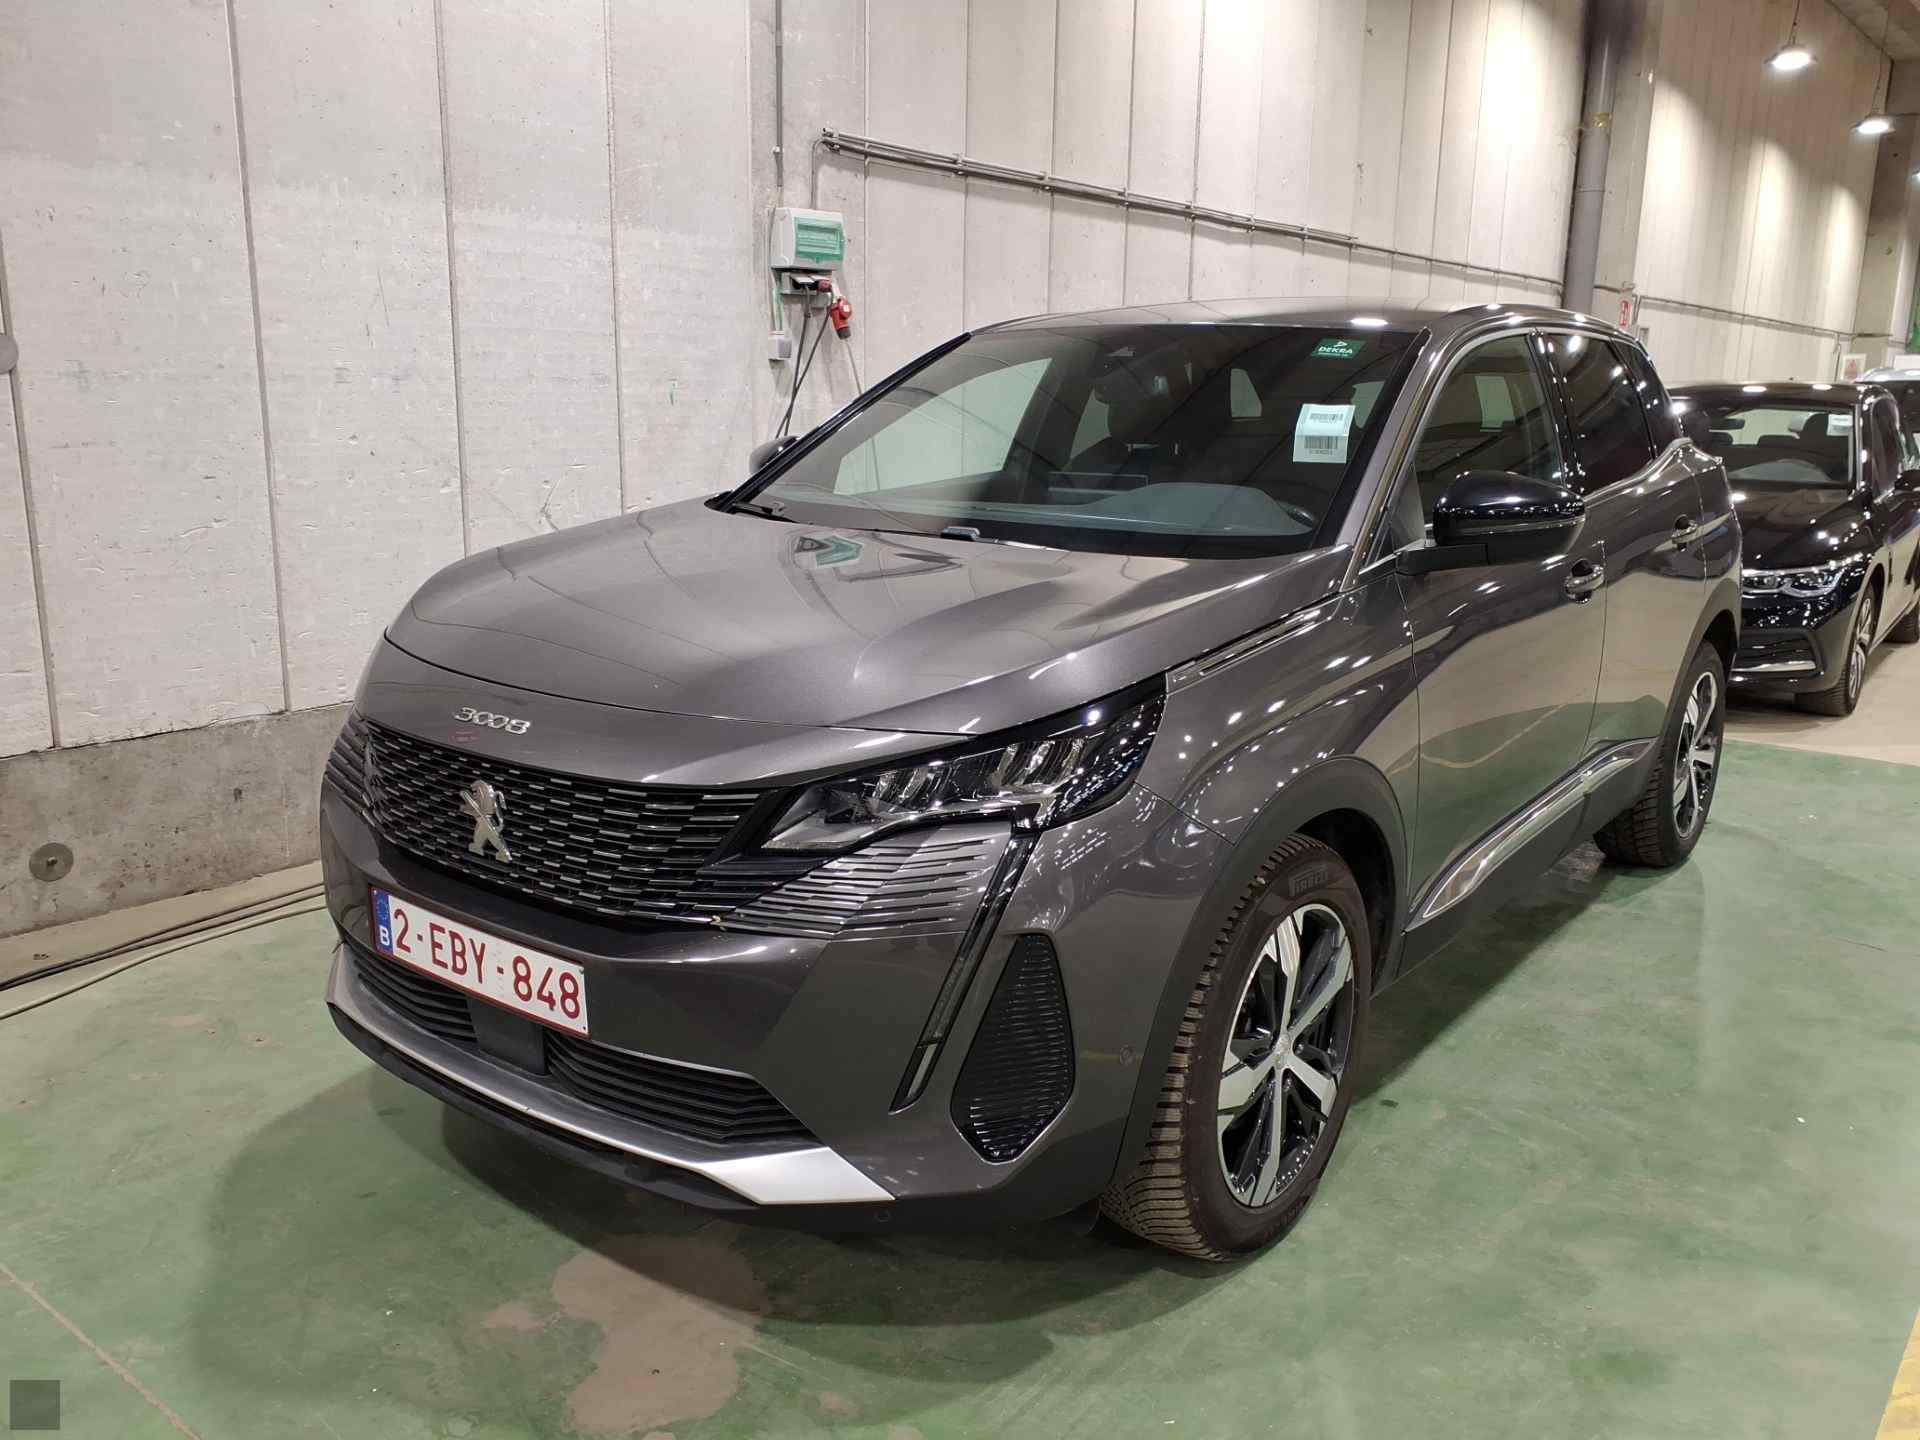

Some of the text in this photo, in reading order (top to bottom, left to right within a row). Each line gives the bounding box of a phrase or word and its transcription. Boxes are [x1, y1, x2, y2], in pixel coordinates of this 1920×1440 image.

[1318, 346, 1353, 354] DEKRA
[454, 706, 531, 734] 3008
[379, 924, 391, 947] B
[393, 908, 581, 1019] 2-EBY-848
